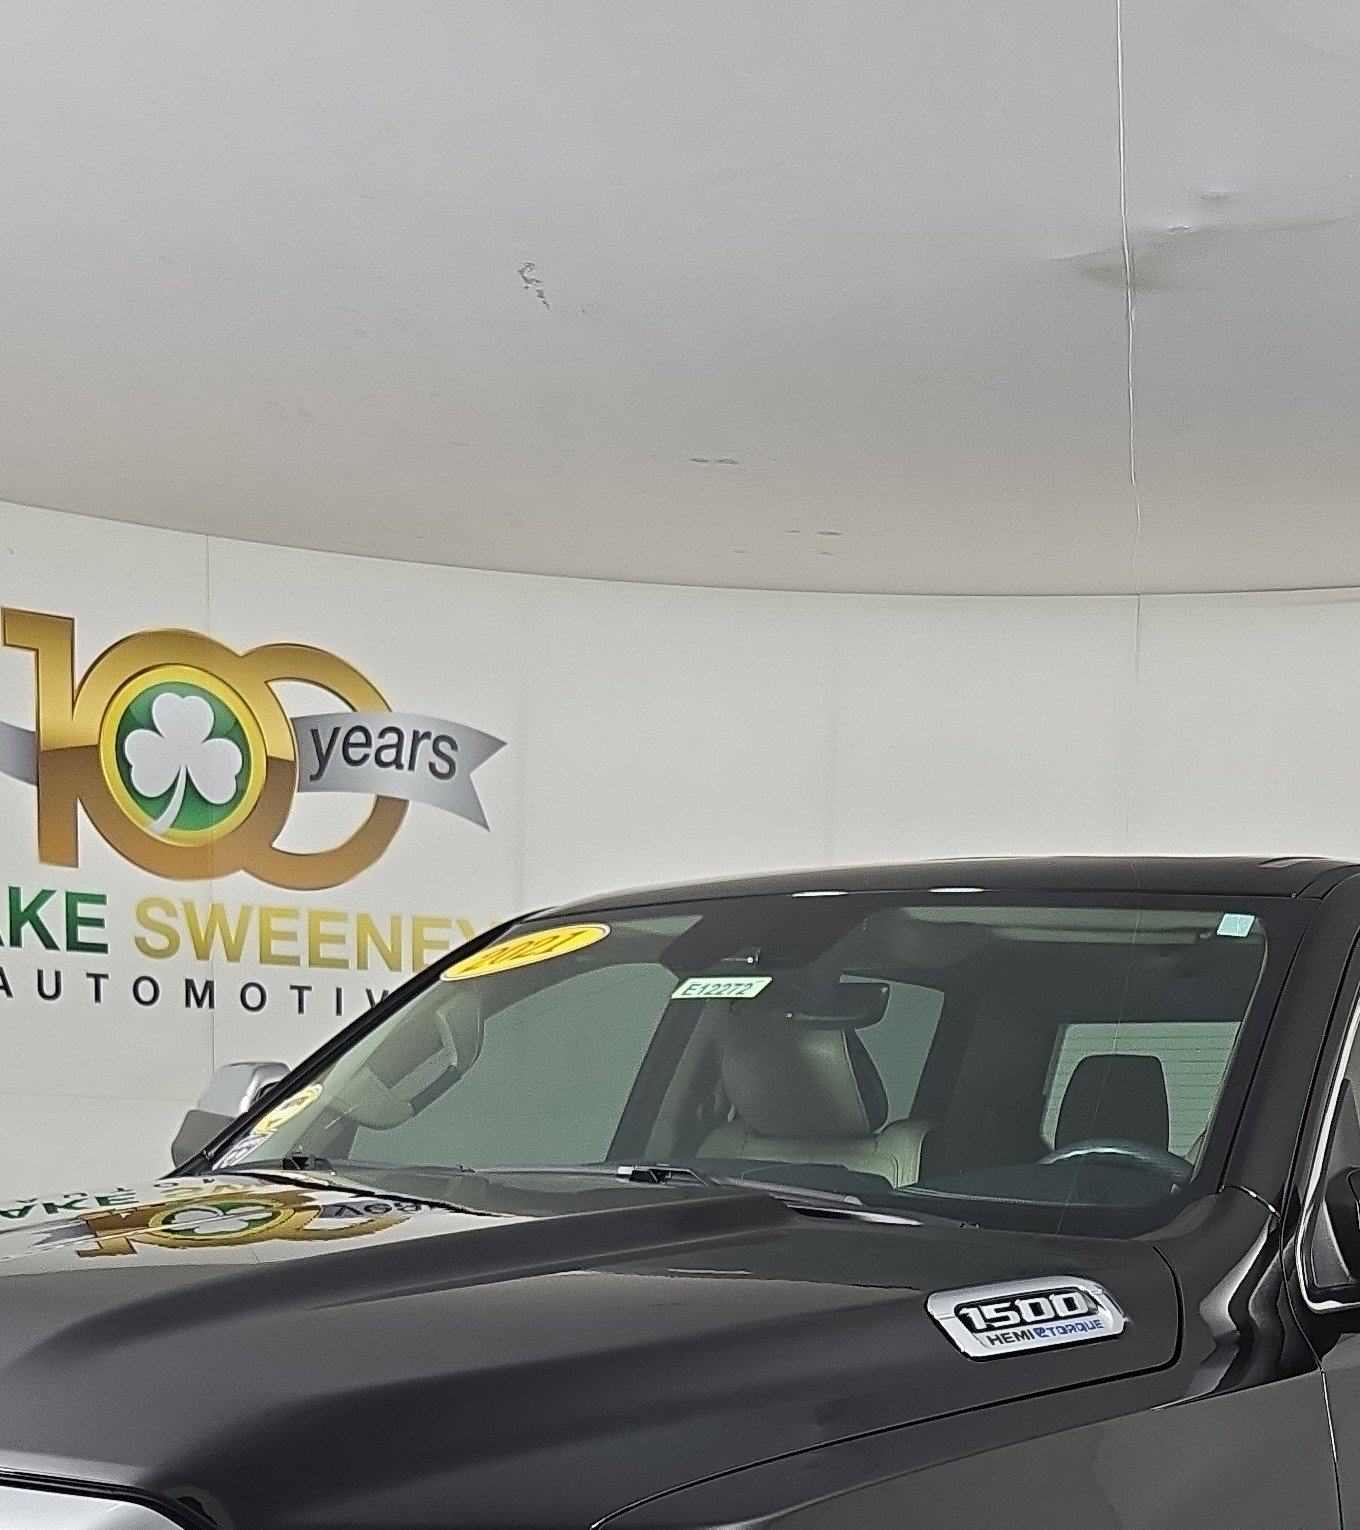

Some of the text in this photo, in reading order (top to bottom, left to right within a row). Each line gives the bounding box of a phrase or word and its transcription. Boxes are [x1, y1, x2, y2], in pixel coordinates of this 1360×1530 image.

[309, 721, 459, 783] years
[681, 983, 754, 996] E12272
[959, 1291, 1090, 1330] 1500
[986, 1329, 1035, 1346] HEMI
